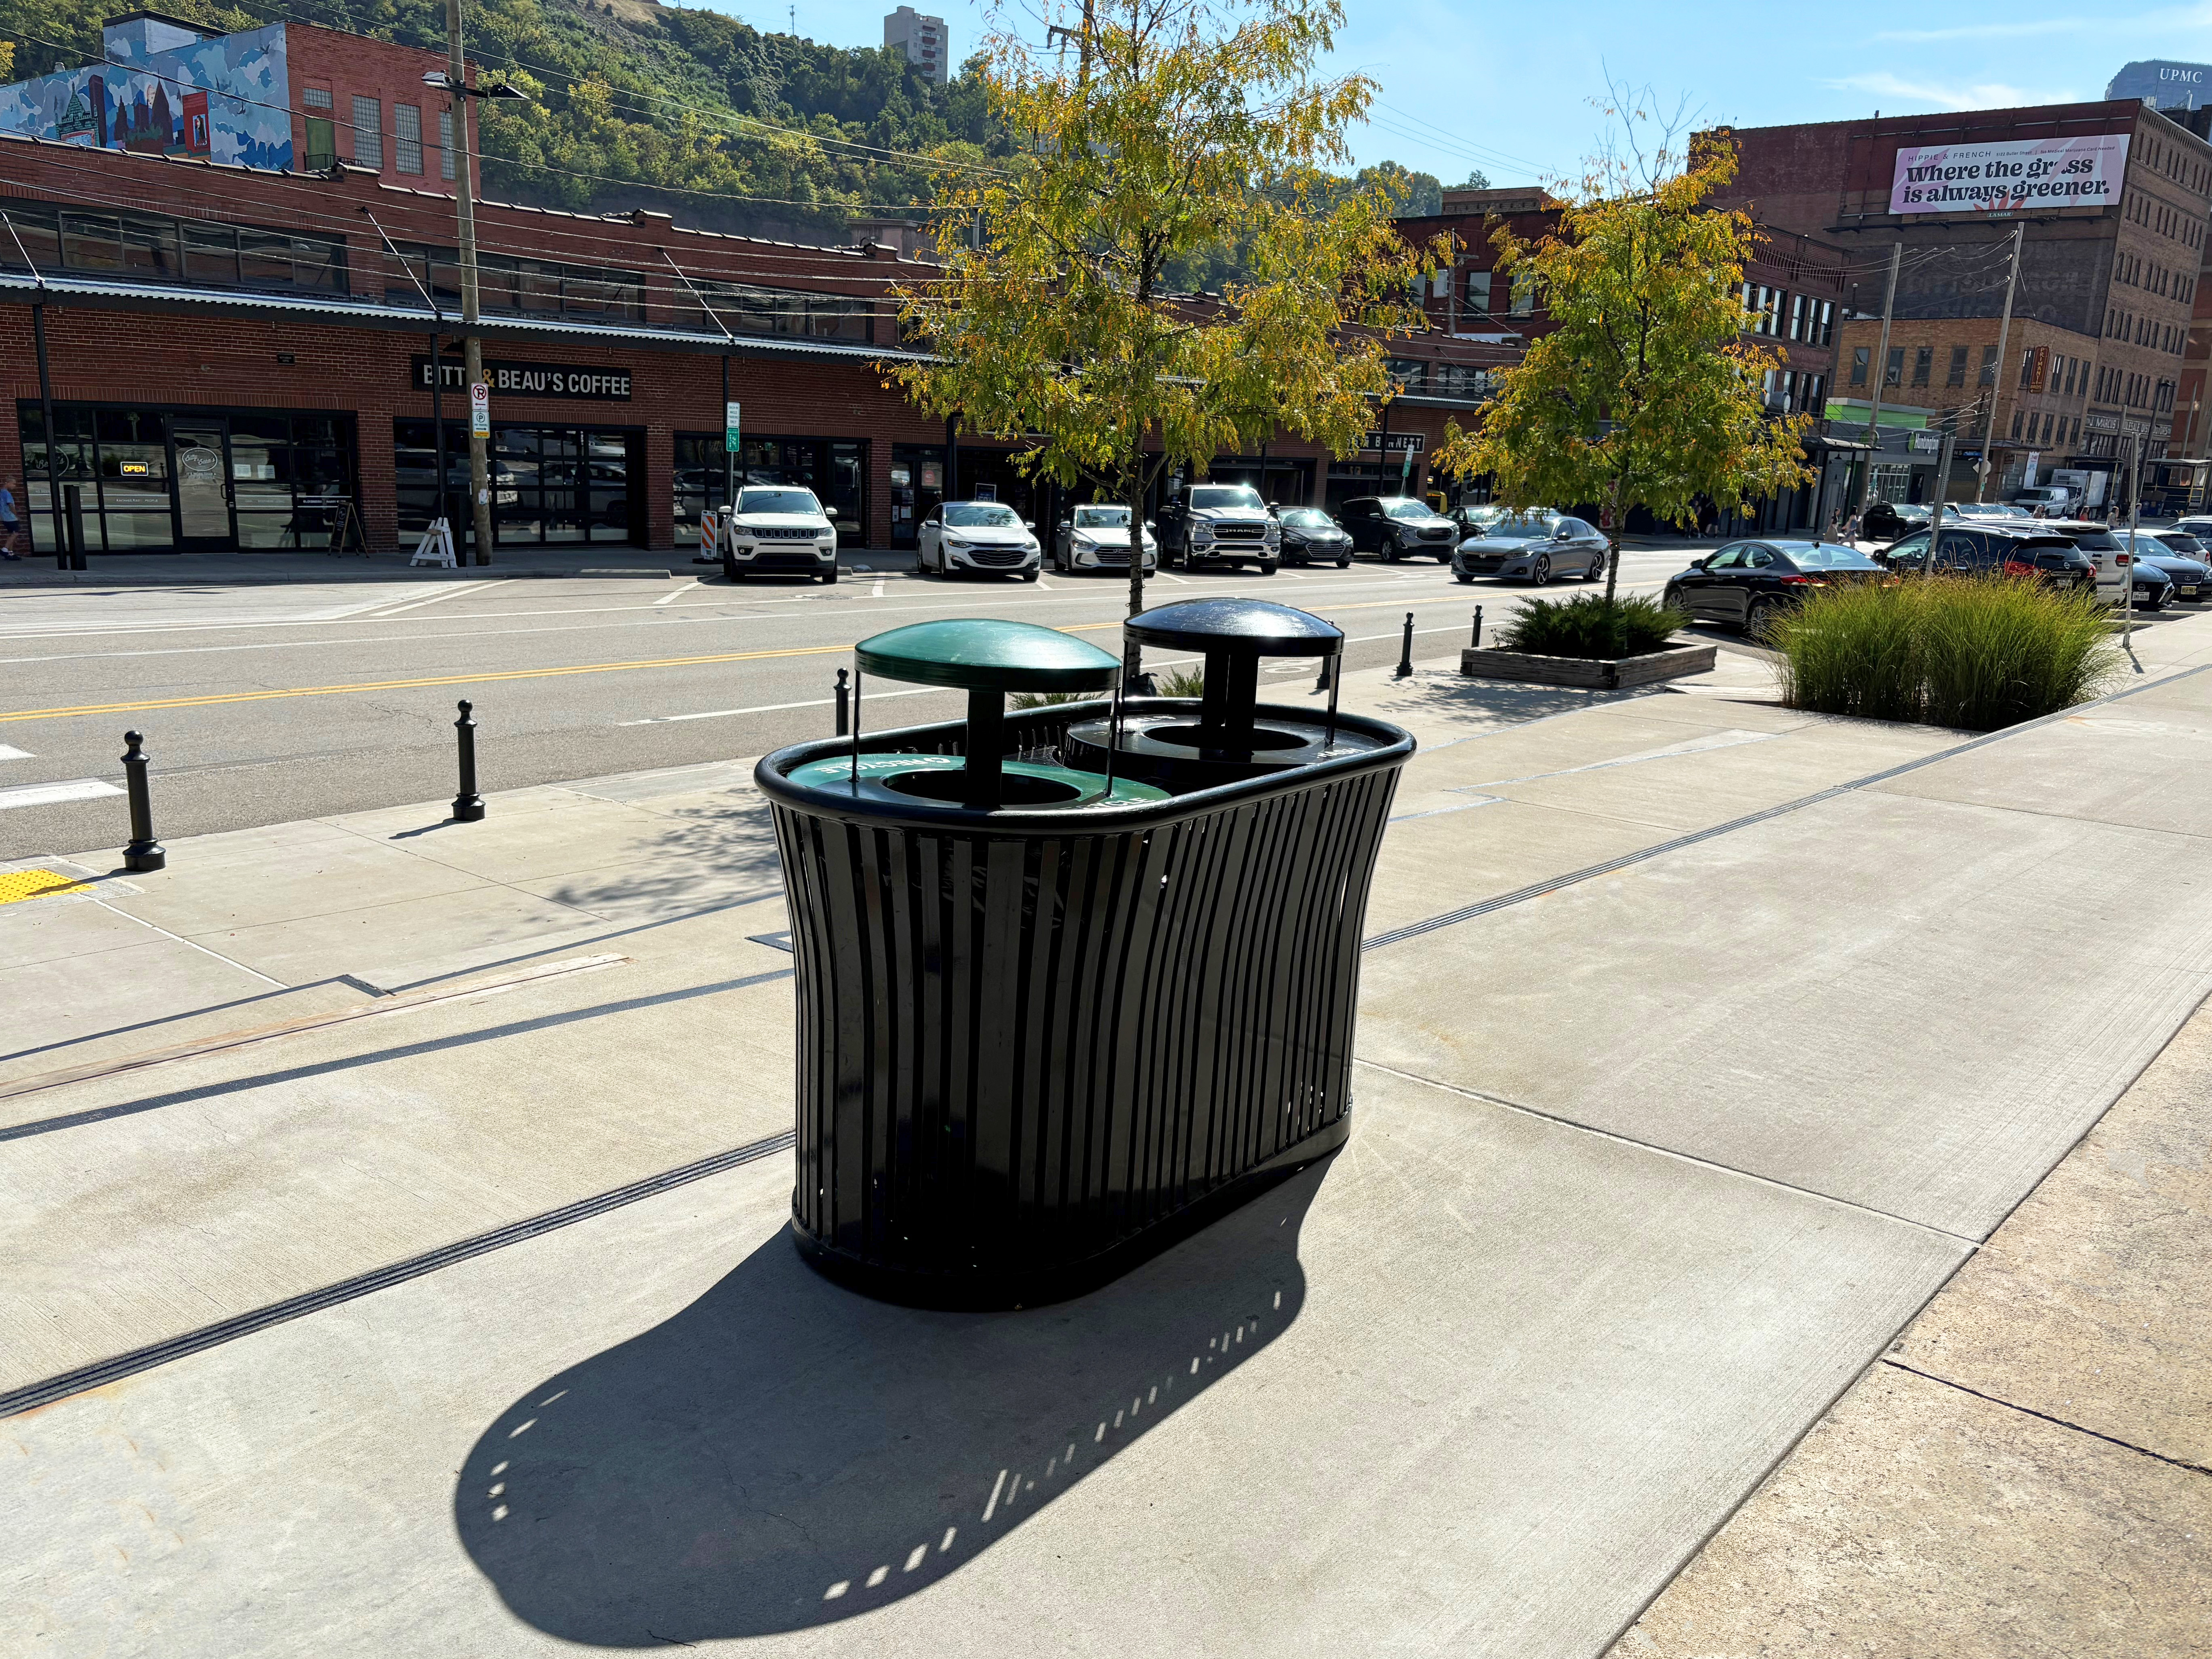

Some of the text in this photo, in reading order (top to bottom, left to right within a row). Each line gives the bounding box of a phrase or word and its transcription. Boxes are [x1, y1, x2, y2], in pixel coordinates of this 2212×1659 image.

[2160, 68, 2202, 83] UPMC
[1953, 151, 1991, 159] FRENCH
[1906, 164, 1980, 182] Where
[1985, 160, 2023, 178] the
[1902, 180, 2110, 203] is always greener.
[483, 368, 495, 388] &
[498, 369, 564, 392] BEAU'S
[568, 374, 630, 395] COFFEE
